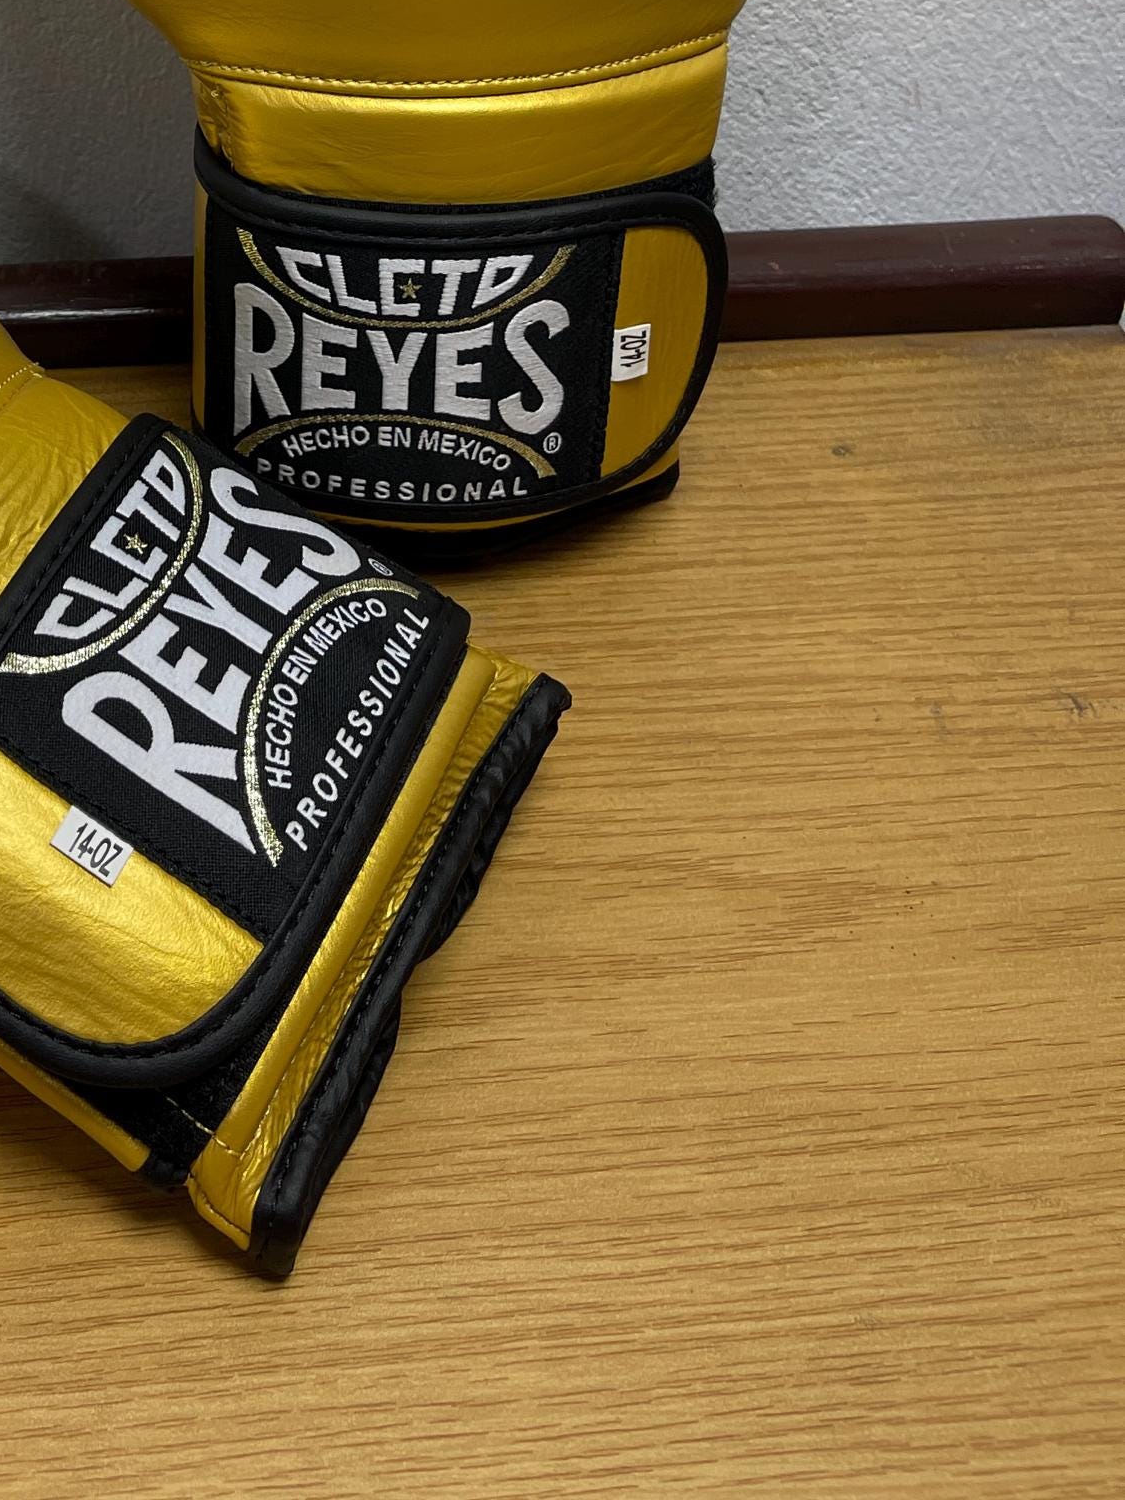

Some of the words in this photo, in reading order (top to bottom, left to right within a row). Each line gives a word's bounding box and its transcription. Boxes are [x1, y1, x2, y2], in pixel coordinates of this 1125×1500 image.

[233, 282, 571, 437] REYES
[256, 456, 528, 504] PROFESSIONAL
[281, 424, 368, 459] HECHO
[377, 425, 412, 449] EN
[416, 430, 512, 471] MEXICO
[61, 466, 362, 855] REYES
[280, 647, 317, 687] EN
[312, 597, 388, 658] MEXICO
[264, 680, 299, 790] HECHO
[284, 607, 431, 852] PROFESSIONAL
